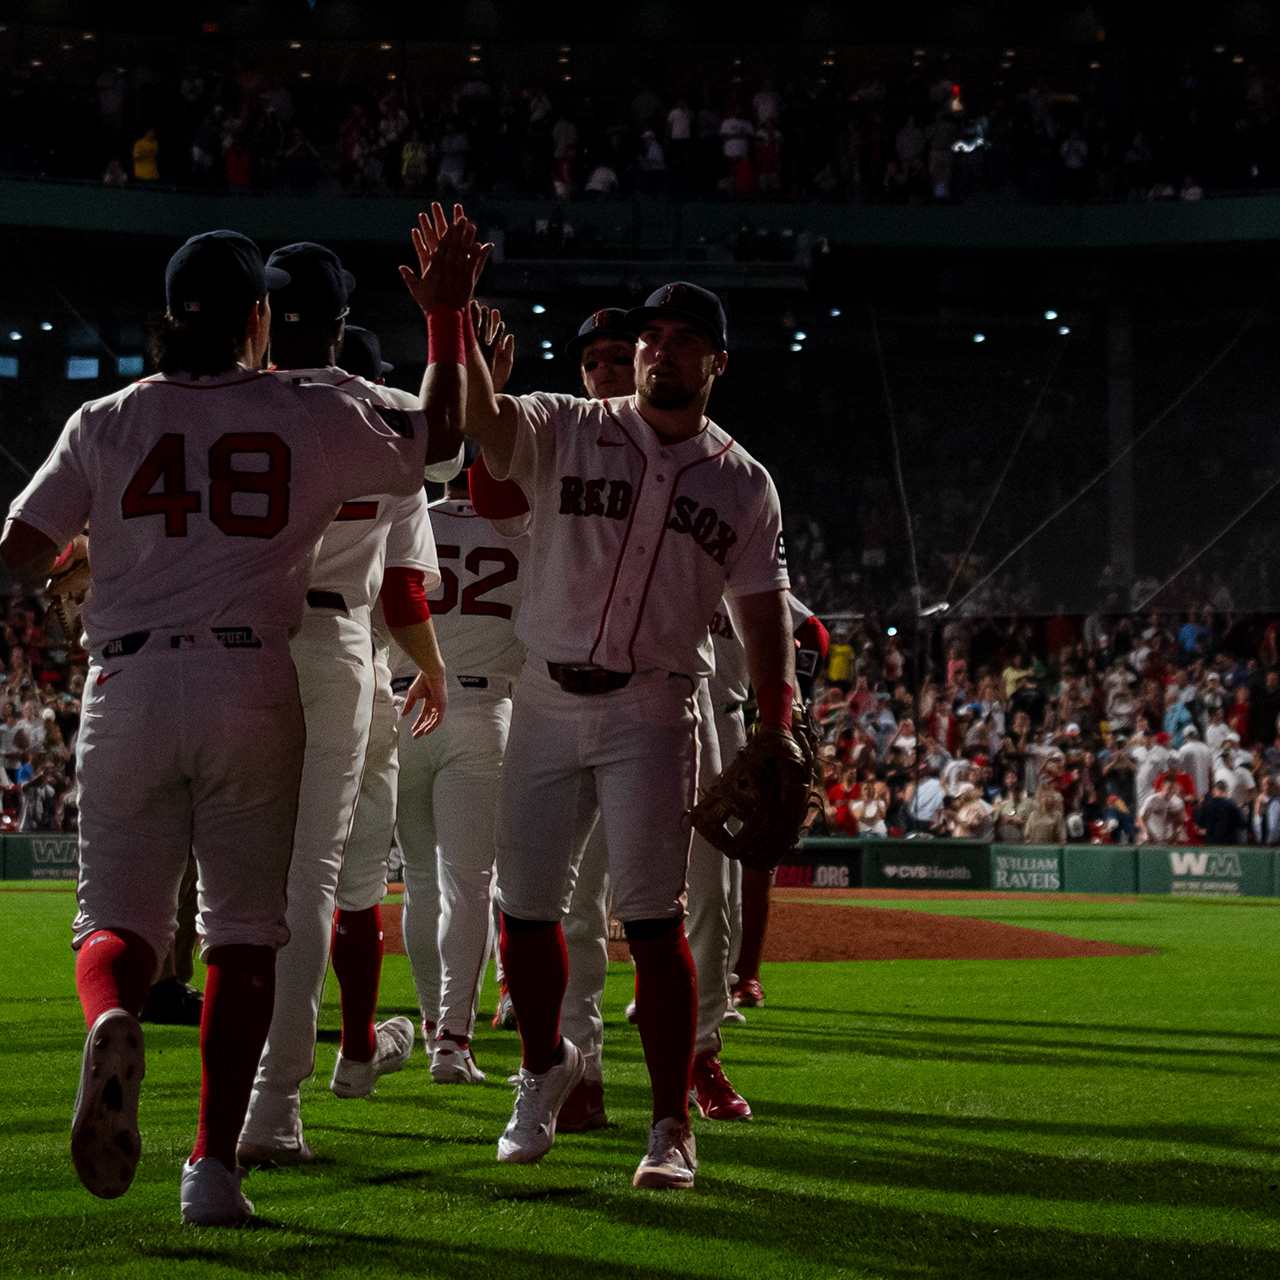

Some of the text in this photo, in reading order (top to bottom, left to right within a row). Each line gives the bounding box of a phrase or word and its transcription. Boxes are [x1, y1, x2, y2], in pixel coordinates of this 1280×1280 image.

[122, 432, 291, 538] 48
[558, 475, 737, 566] RED SOX
[428, 544, 520, 620] 52
[709, 611, 734, 640] OX
[996, 856, 1060, 871] WILLIAM
[996, 871, 1061, 890] RAVEIS
